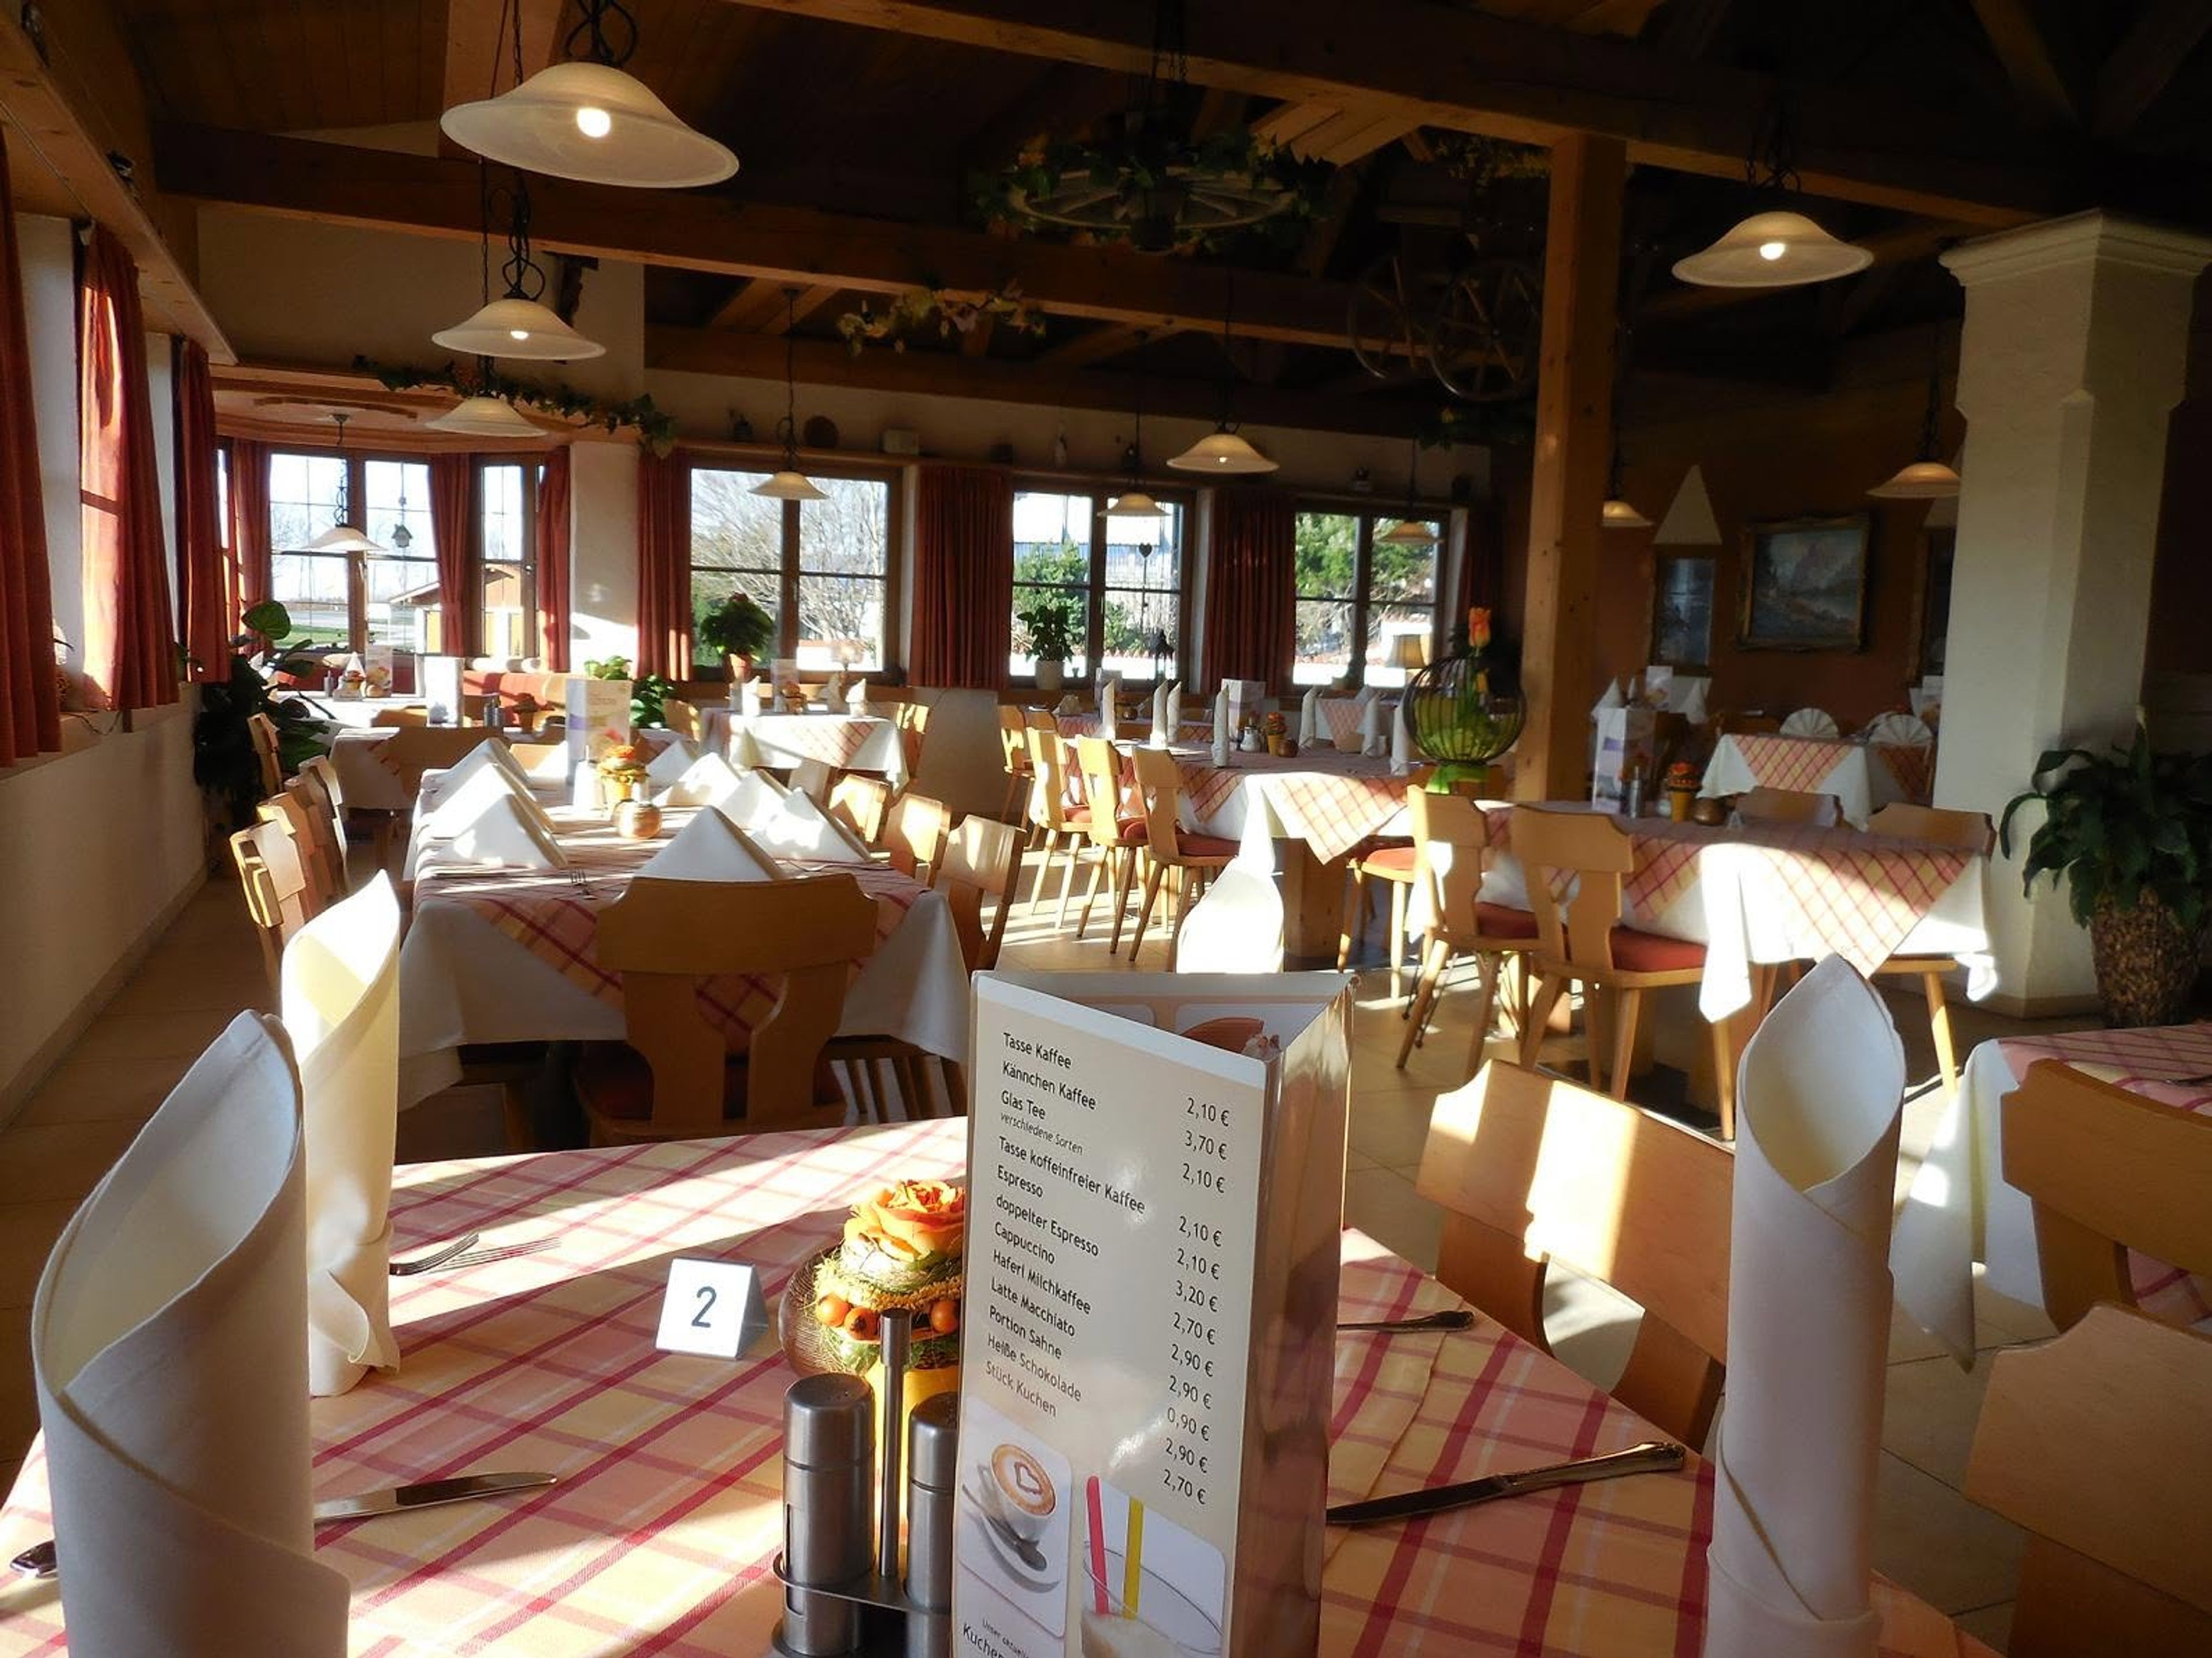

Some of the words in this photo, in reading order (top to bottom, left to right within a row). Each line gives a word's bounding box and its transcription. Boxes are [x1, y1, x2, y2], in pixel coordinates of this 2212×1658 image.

[1003, 1032, 1032, 1054] Tasse
[1036, 1044, 1071, 1069] Kaffee
[1002, 1061, 1055, 1092] Kännchen
[1059, 1083, 1096, 1110] Kaffee
[1001, 1090, 1023, 1111] Glas
[1027, 1099, 1046, 1120] Tee
[1188, 1098, 1217, 1122] 2,10
[1220, 1109, 1230, 1126] €
[1001, 1112, 1054, 1142] verschiedene
[1056, 1135, 1083, 1155] Sorten
[1185, 1130, 1214, 1154] 3,70
[1218, 1143, 1228, 1160] €
[997, 1165, 1043, 1198] Espresso
[999, 1136, 1027, 1160] Tasse
[1030, 1149, 1101, 1194] koffeinfreier
[1105, 1183, 1145, 1215] Kaffee
[1183, 1163, 1212, 1188] 2,10
[1216, 1177, 1225, 1194] €
[996, 1194, 1048, 1230] doppelter
[1051, 1220, 1099, 1257] Espresso
[1179, 1216, 1208, 1240] 2,10
[1213, 1230, 1222, 1247] €
[995, 1222, 1055, 1265] Cappuccino
[1177, 1248, 1206, 1273] 2,10
[1211, 1263, 1220, 1280] €
[993, 1249, 1024, 1279] Haferl
[1028, 1269, 1092, 1315] Milchkaffee
[1176, 1280, 1205, 1306] 3,20
[1209, 1295, 1218, 1312] €
[691, 1286, 717, 1327] 2
[991, 1276, 1018, 1303] Latte
[1021, 1295, 1075, 1337] Macchiato
[990, 1305, 1025, 1338] Portion
[1029, 1328, 1062, 1360] Sahne
[1173, 1312, 1202, 1338] 2,70
[1207, 1328, 1216, 1345] €
[988, 1333, 1017, 1361] Heiße
[1020, 1353, 1081, 1402] Schokolade
[1172, 1344, 1200, 1371] 2,90
[1205, 1360, 1213, 1377] €
[986, 1360, 1013, 1389] Stück
[1016, 1379, 1056, 1418] Kuchen
[1169, 1375, 1198, 1402] 2,90
[1203, 1393, 1211, 1410] €
[1168, 1407, 1196, 1435] 0,90
[1201, 1425, 1209, 1441] €
[1166, 1438, 1195, 1466] 2,90
[1199, 1456, 1208, 1473] €
[1163, 1469, 1192, 1497] 2,70
[1197, 1488, 1206, 1504] €
